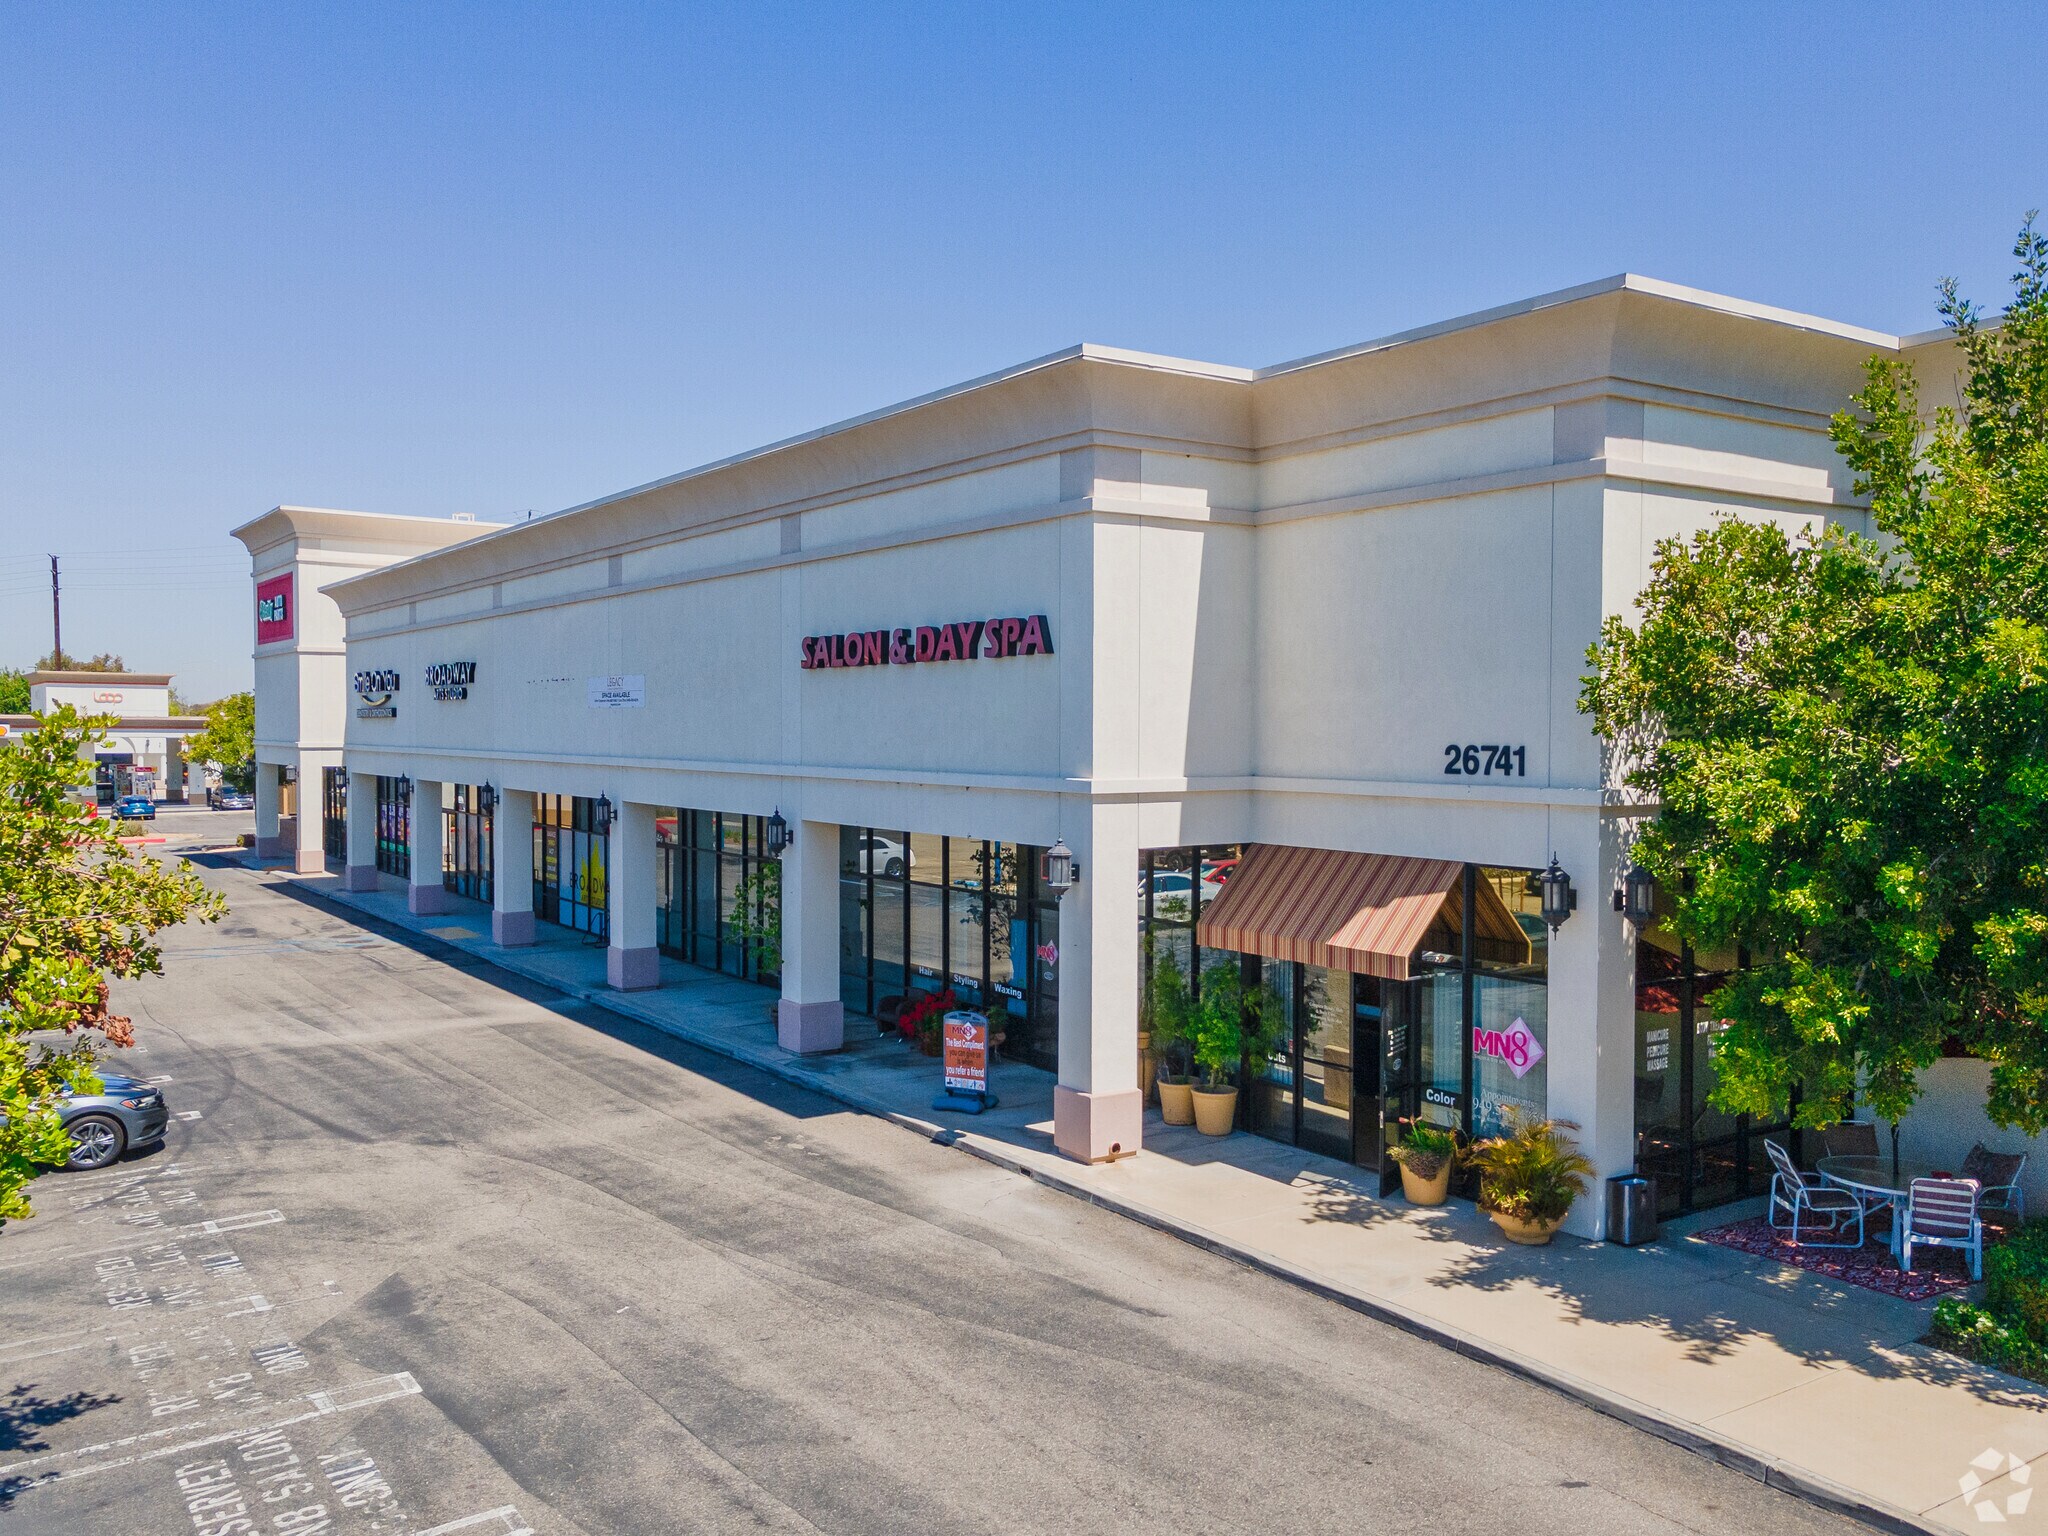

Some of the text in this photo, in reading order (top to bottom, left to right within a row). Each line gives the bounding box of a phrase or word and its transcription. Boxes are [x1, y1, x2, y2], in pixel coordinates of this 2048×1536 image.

[801, 615, 1054, 669] SALON & DAY SPA
[425, 662, 475, 687] BROADWAY
[1444, 744, 1525, 777] 26741
[918, 966, 933, 977] Hair
[953, 974, 978, 989] Styling
[994, 983, 1022, 999] Waxing
[952, 1025, 972, 1037] MN8
[1472, 1026, 1529, 1067] MN8
[946, 1066, 955, 1075] you
[955, 1066, 967, 1075] refer
[970, 1066, 984, 1077] friend
[1426, 1089, 1456, 1106] Color
[237, 1428, 314, 1502] SALON
